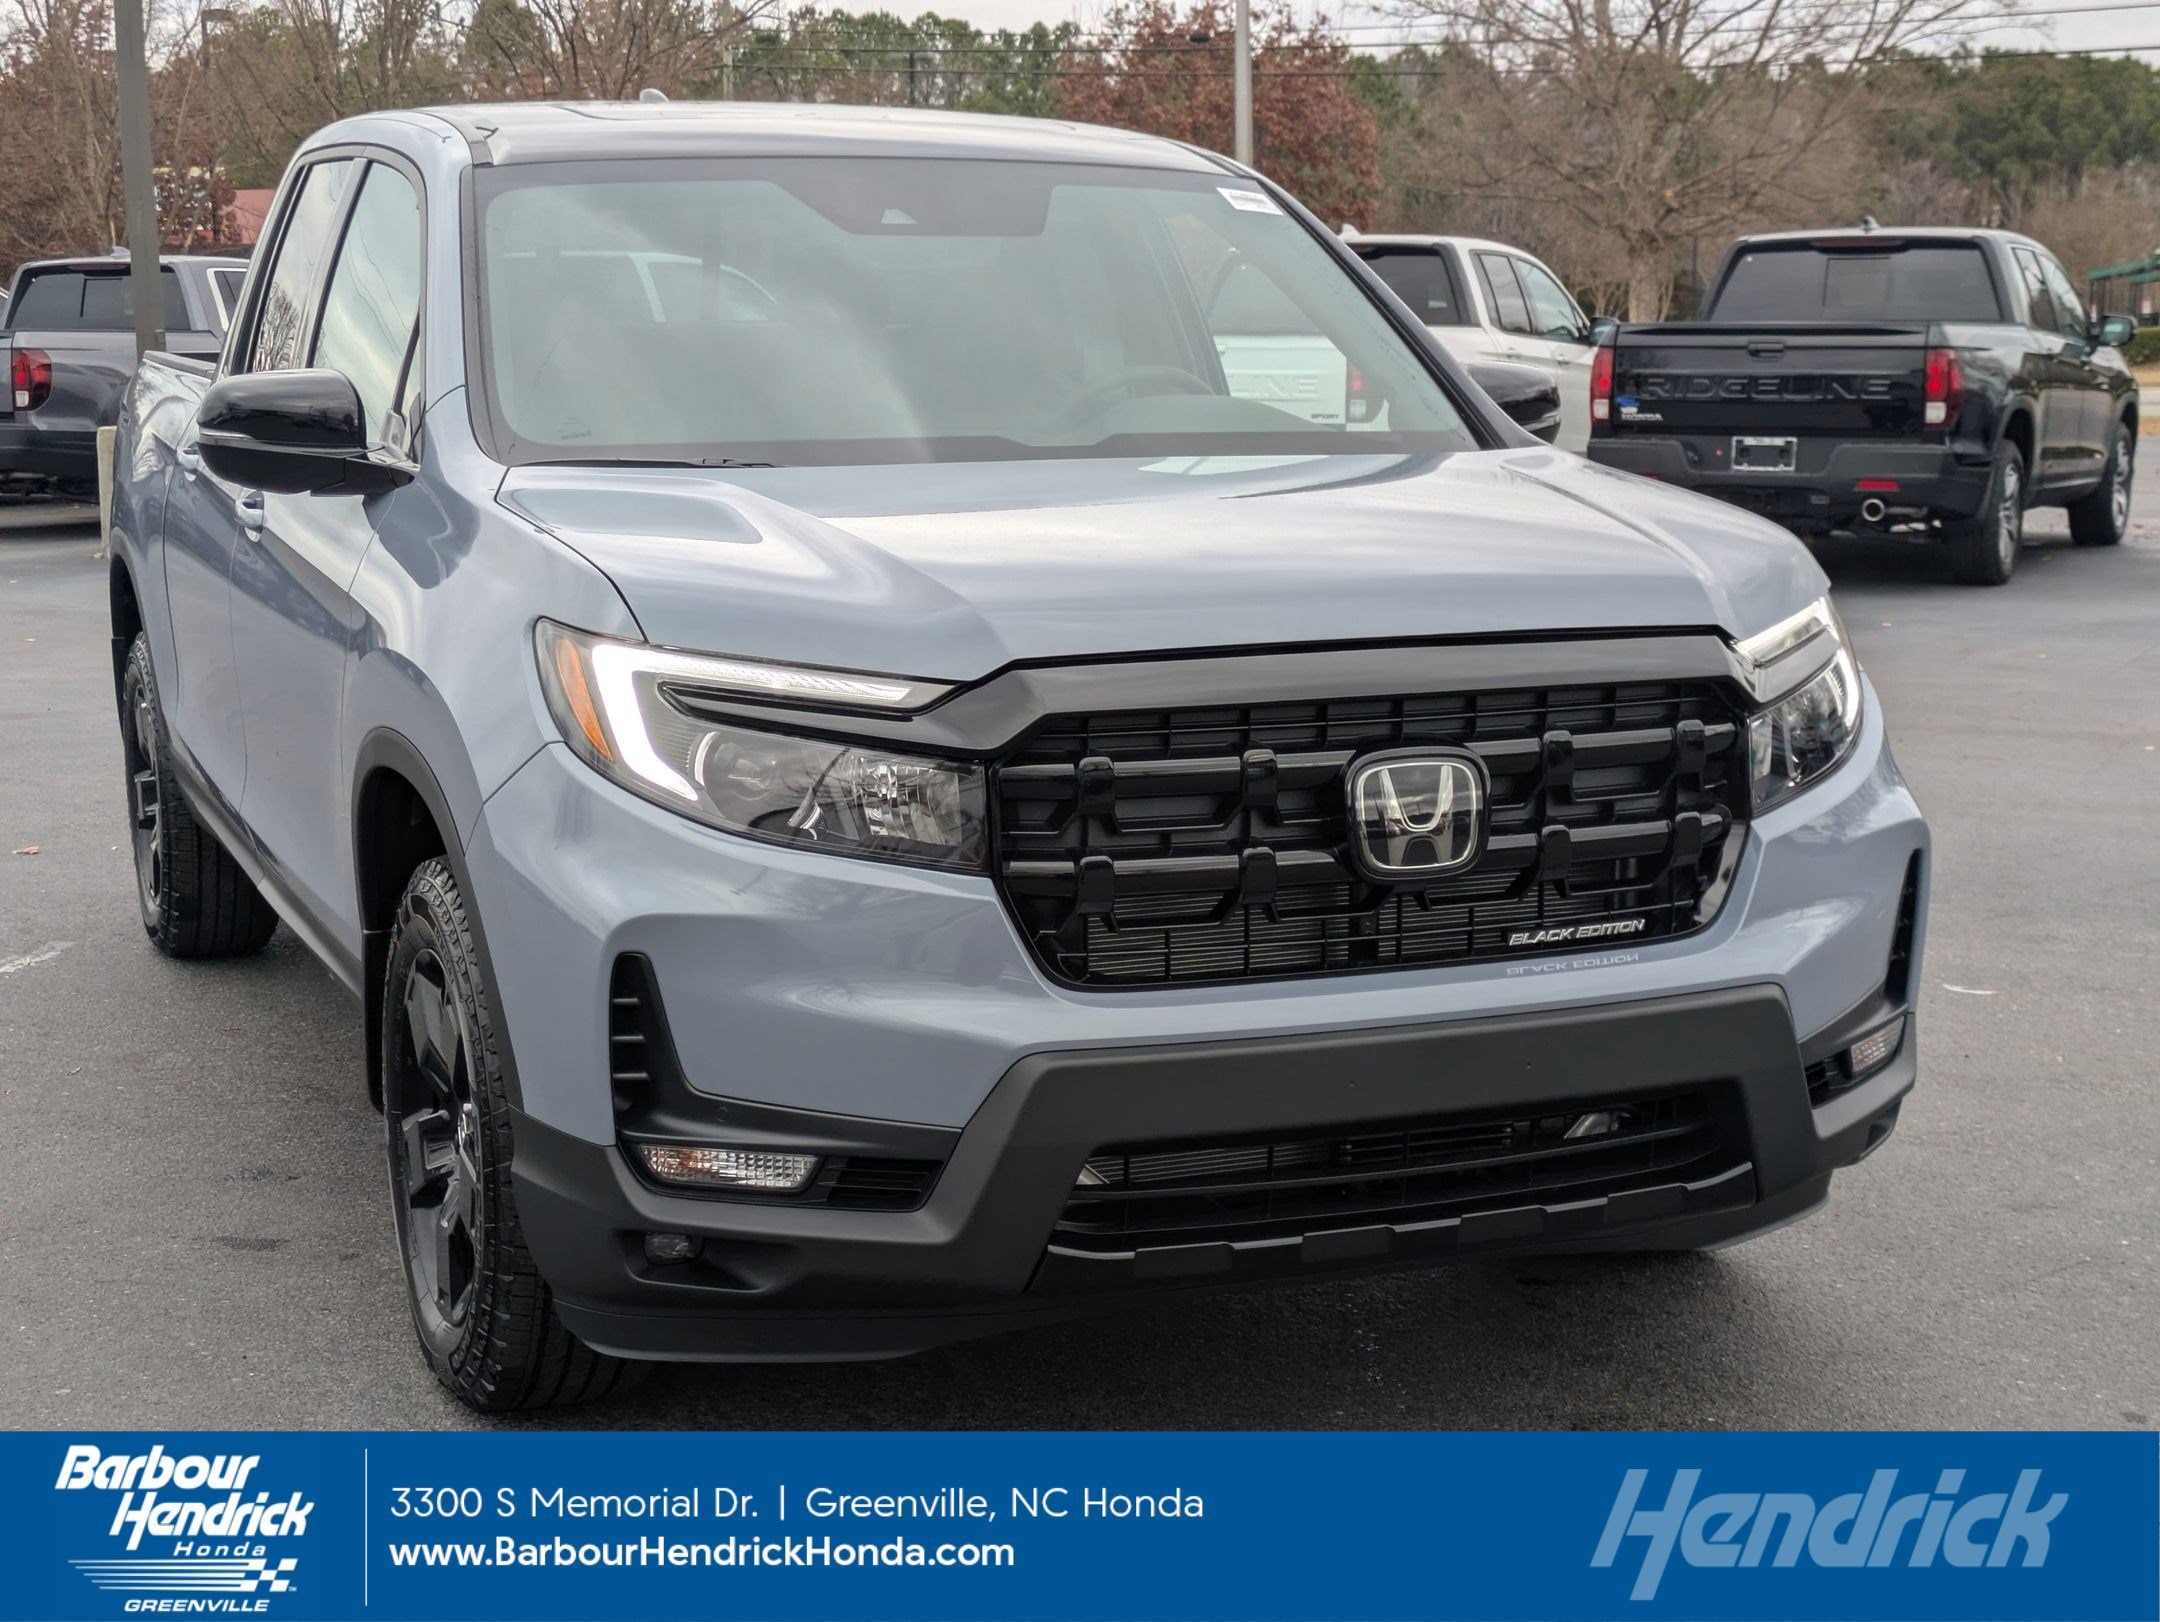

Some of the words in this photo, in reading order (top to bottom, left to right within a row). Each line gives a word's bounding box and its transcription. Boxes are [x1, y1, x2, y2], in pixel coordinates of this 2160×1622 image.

[1641, 378, 1892, 400] RIDGELINE
[1509, 927, 1575, 946] BLACK
[1576, 918, 1646, 939] EDITION
